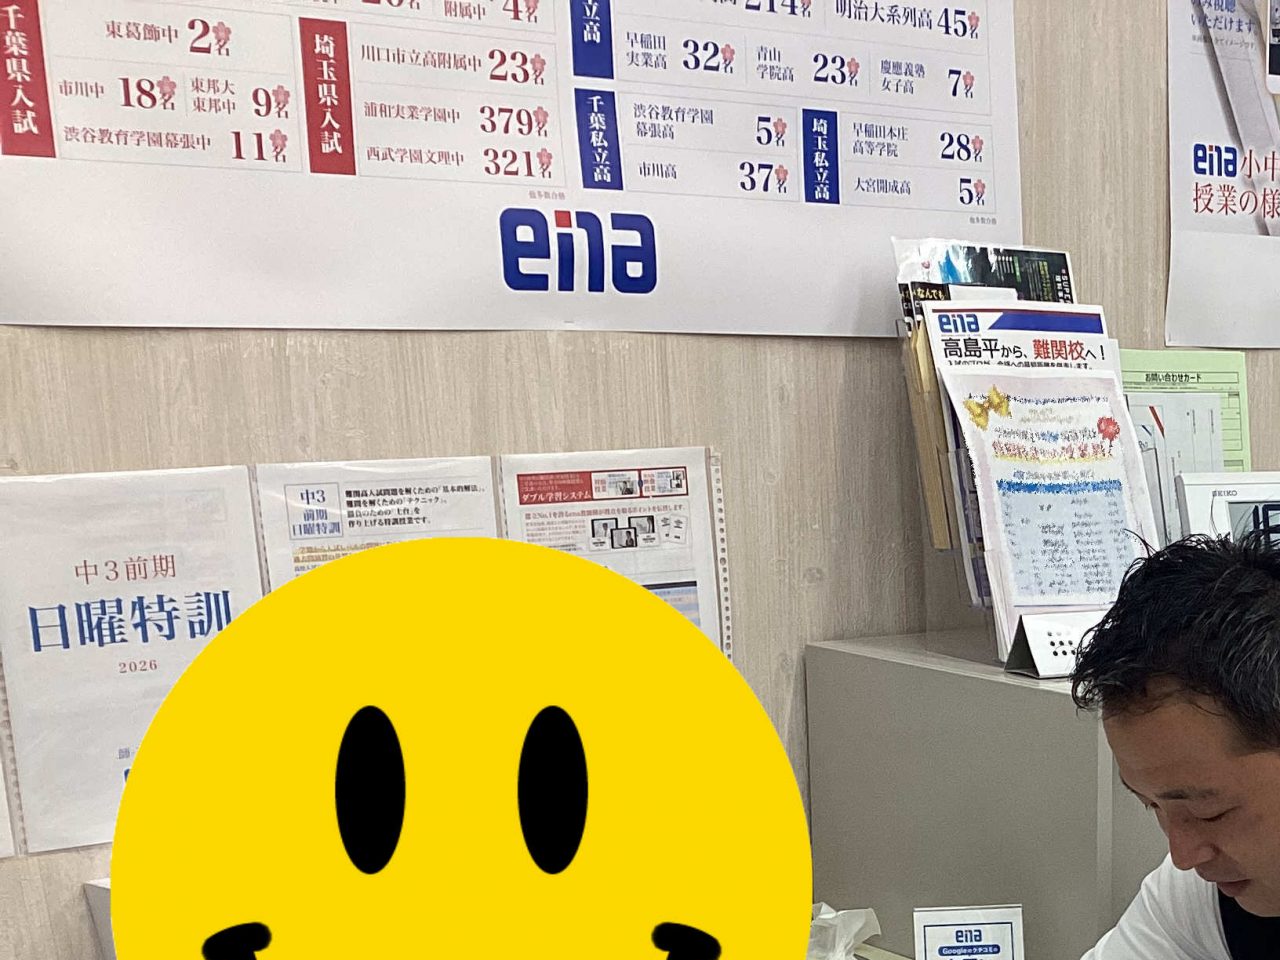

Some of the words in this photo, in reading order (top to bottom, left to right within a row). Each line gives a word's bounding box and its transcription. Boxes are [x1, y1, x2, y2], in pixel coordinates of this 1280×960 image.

[583, 0, 601, 44] 立高
[836, 0, 932, 30] 明治大系列高
[106, 20, 179, 44] 東葛飾中
[626, 31, 666, 51] 早稲田
[361, 44, 482, 72] 川口市立高附属中
[626, 51, 667, 70] 実業高
[757, 46, 781, 63] 青山
[1, 5, 39, 135] 千葉県入試
[757, 65, 794, 82] 学院高
[881, 60, 925, 78] 慶應義塾
[59, 80, 105, 98] 市川中
[191, 77, 236, 96] 東邦大
[314, 34, 342, 154] 埼玉県入試
[882, 78, 914, 95] 女子高
[193, 97, 236, 114] 東邦中
[364, 102, 460, 124] 浦和実業学園中
[633, 102, 714, 125] 渋谷教育学園
[64, 126, 211, 150] 渋谷教育学園幕張中
[586, 96, 611, 183] 千葉私立高
[637, 124, 675, 140] 幕張高
[853, 122, 908, 141] 早稲田本庄
[367, 146, 464, 167] 西武学園文理中
[812, 118, 830, 200] 埼玉私立高
[853, 141, 898, 158] 高等学院
[1193, 143, 1237, 178] ena
[639, 162, 677, 179] 市川高
[854, 177, 911, 195] 大宮開成高
[499, 207, 657, 294] ena
[938, 314, 979, 333] ena
[1146, 373, 1201, 382] お問い合わせカード
[300, 489, 326, 505] 中3
[304, 508, 328, 521] 前期
[293, 522, 340, 536] 日曜特訓
[74, 554, 176, 585] 中3前期
[28, 590, 232, 652] 日曜特訓
[118, 660, 158, 673] 2026
[955, 929, 982, 943] ena
